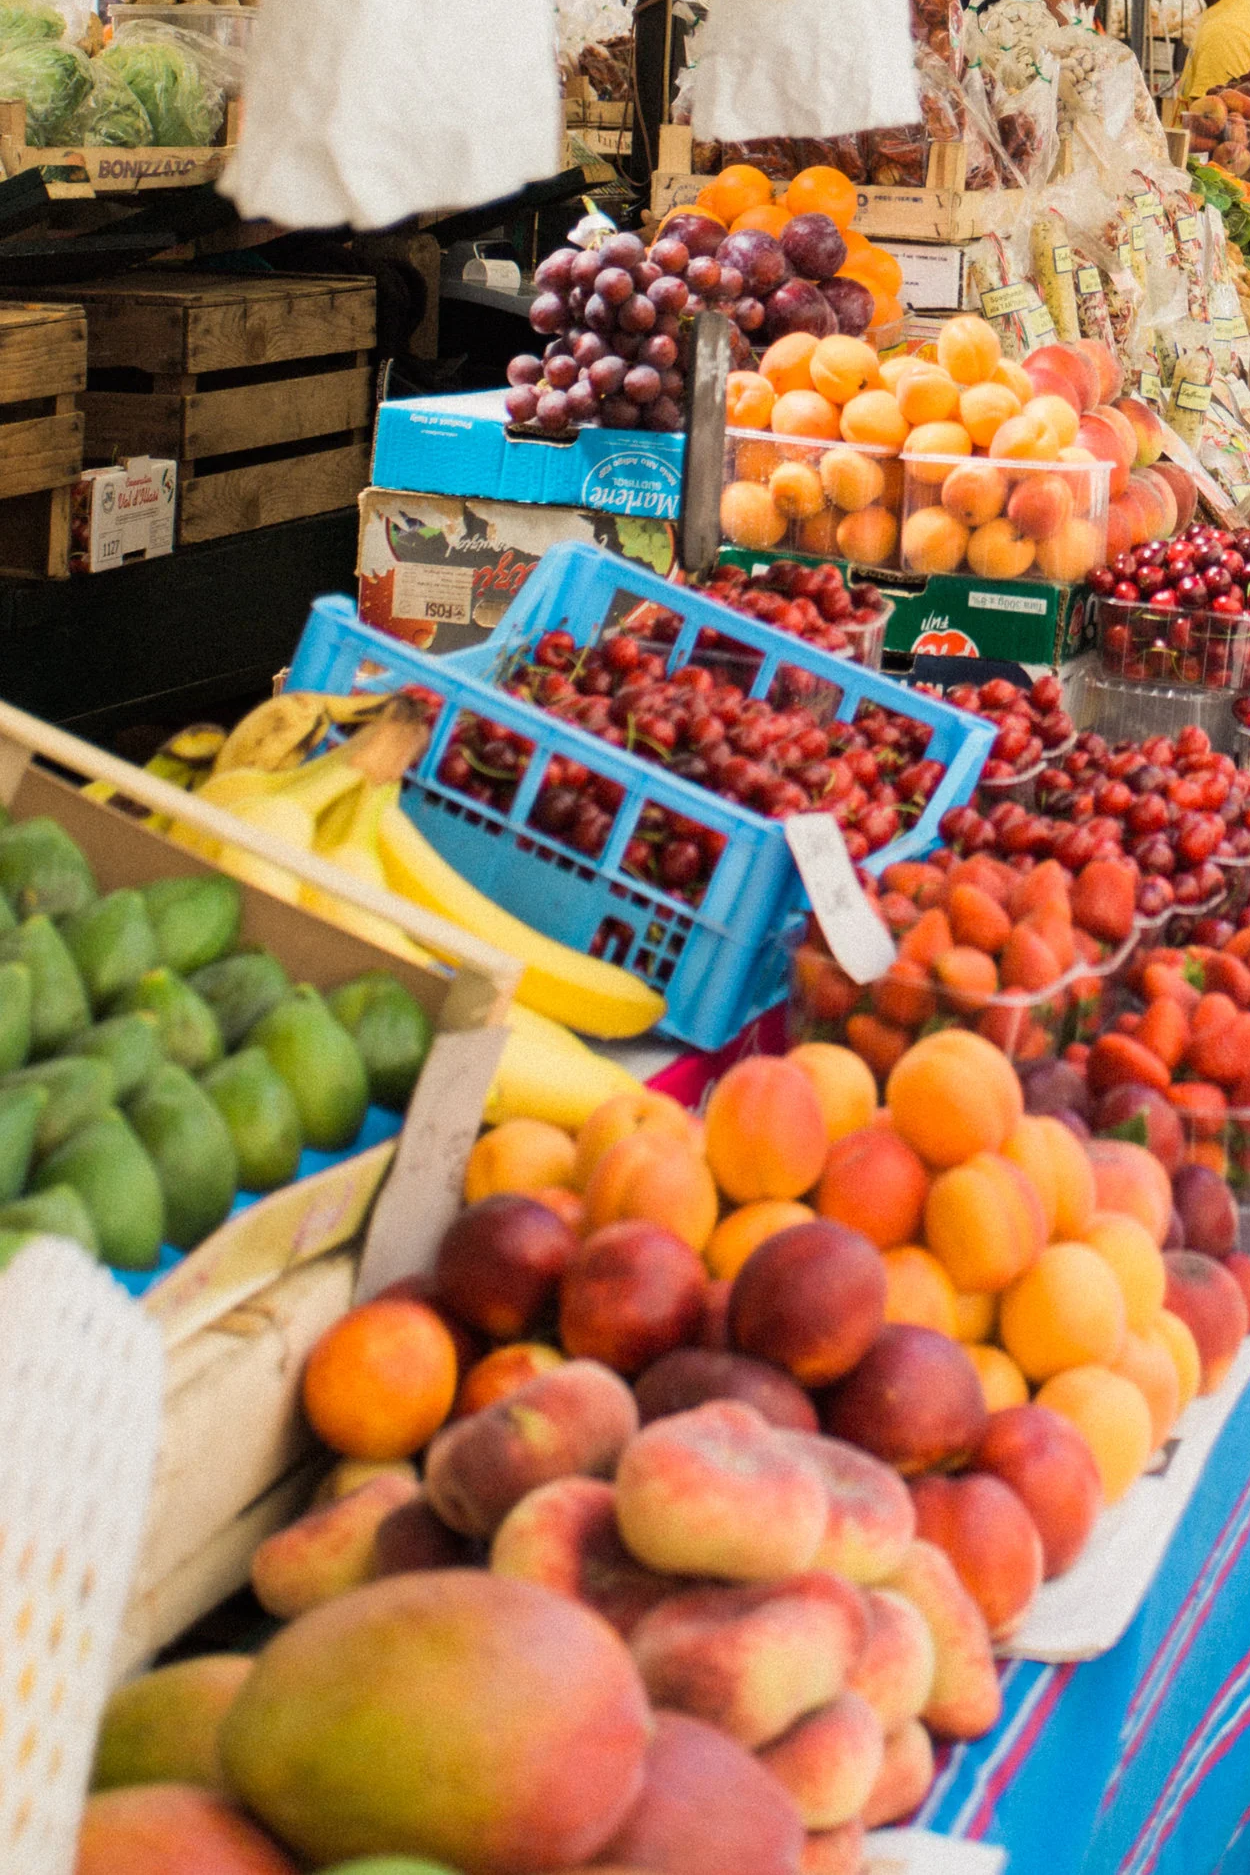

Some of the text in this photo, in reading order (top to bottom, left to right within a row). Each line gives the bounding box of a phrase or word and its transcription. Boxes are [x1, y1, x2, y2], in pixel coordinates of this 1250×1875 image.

[103, 539, 121, 558] 1127
[424, 601, 453, 620] FOSI
[920, 609, 949, 631] FUJI
